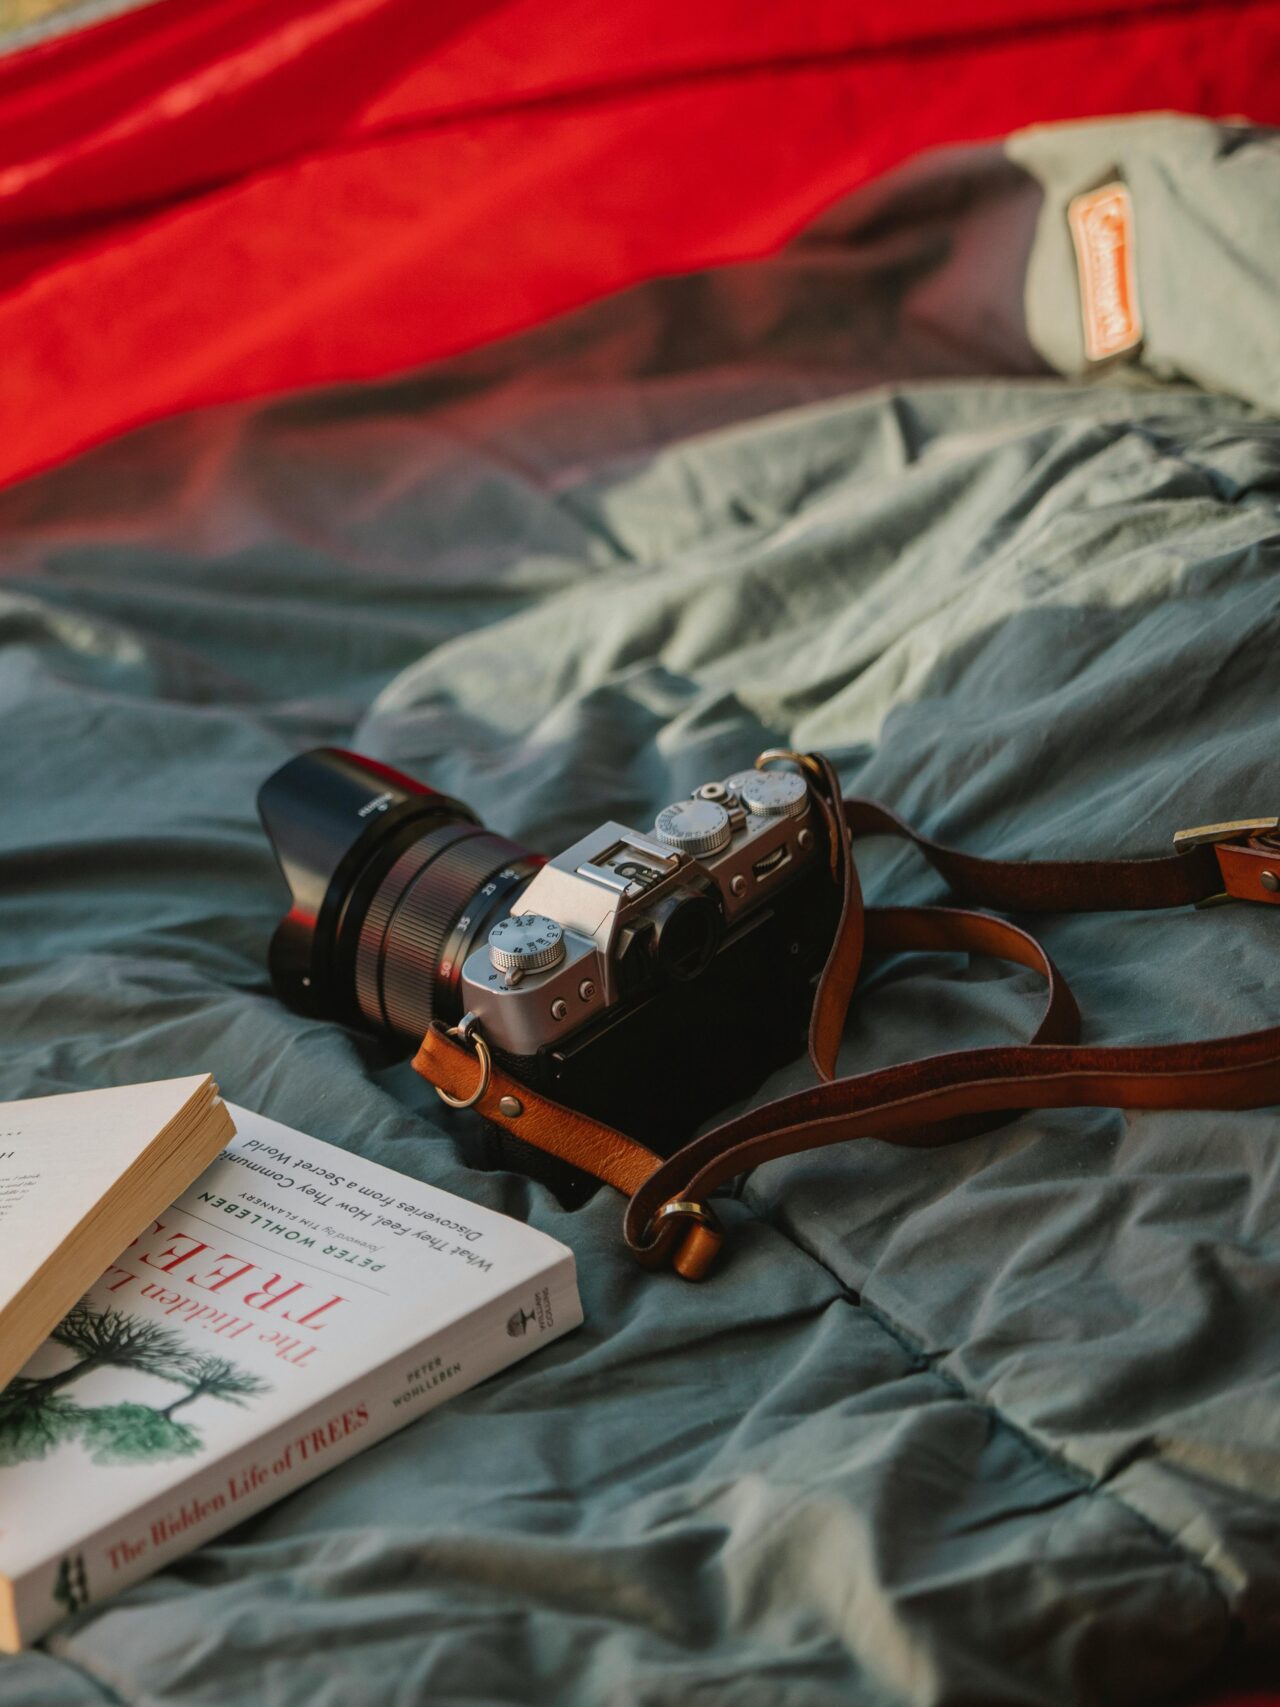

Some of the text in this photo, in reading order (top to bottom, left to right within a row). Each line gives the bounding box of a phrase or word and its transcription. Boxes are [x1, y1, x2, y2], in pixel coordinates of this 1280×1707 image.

[457, 916, 470, 931] 35
[440, 960, 452, 978] 50
[242, 1139, 484, 1242] Discoveries from a Secret World
[296, 1184, 334, 1207] They
[239, 1191, 385, 1253] foreword by TIM FLANNERY
[335, 1202, 372, 1222] How
[371, 1214, 412, 1237] Feel,
[197, 1191, 387, 1273] PETER WOHLLEBEN
[410, 1230, 449, 1252] They
[449, 1245, 495, 1273] What
[139, 1282, 256, 1341] Hidden
[259, 1330, 320, 1368] The
[406, 1356, 442, 1383] PETER
[392, 1362, 462, 1408] WOHLLEBEN
[107, 1401, 370, 1569] The Hidden Life of TREES
